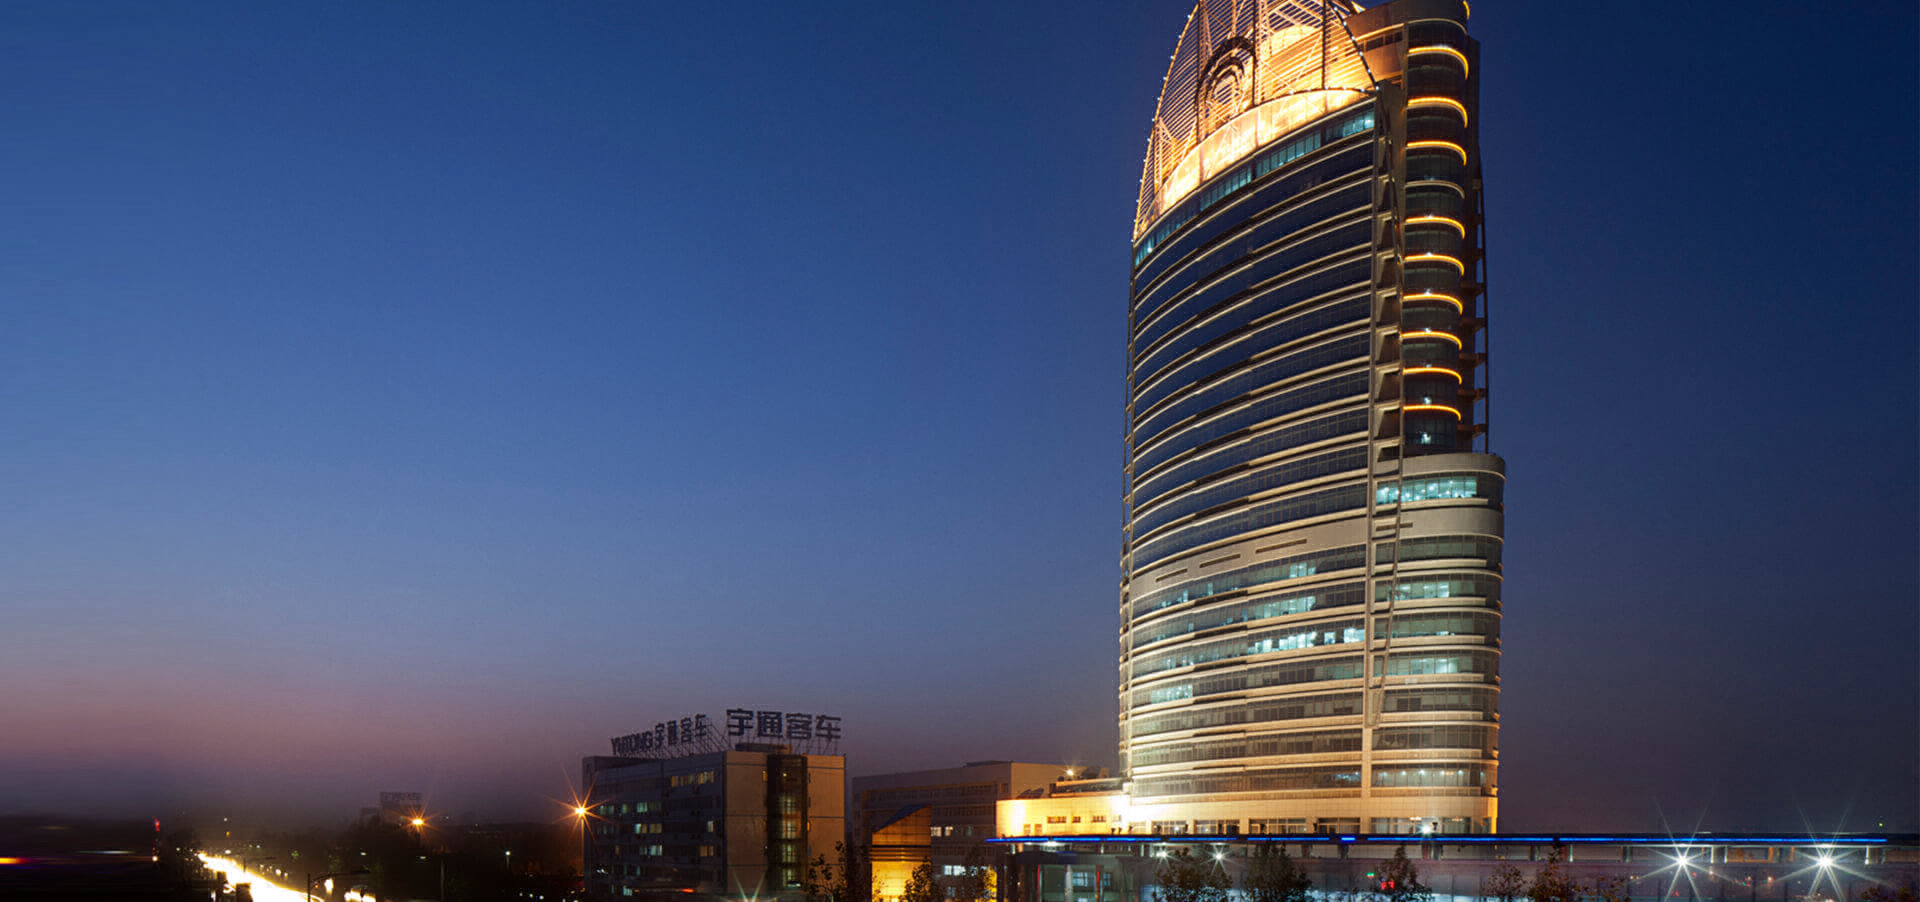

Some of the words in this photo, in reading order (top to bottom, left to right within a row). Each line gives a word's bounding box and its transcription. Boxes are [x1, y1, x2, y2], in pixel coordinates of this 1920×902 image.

[655, 714, 707, 749] 宇通客车
[726, 708, 842, 741] 宇通客车
